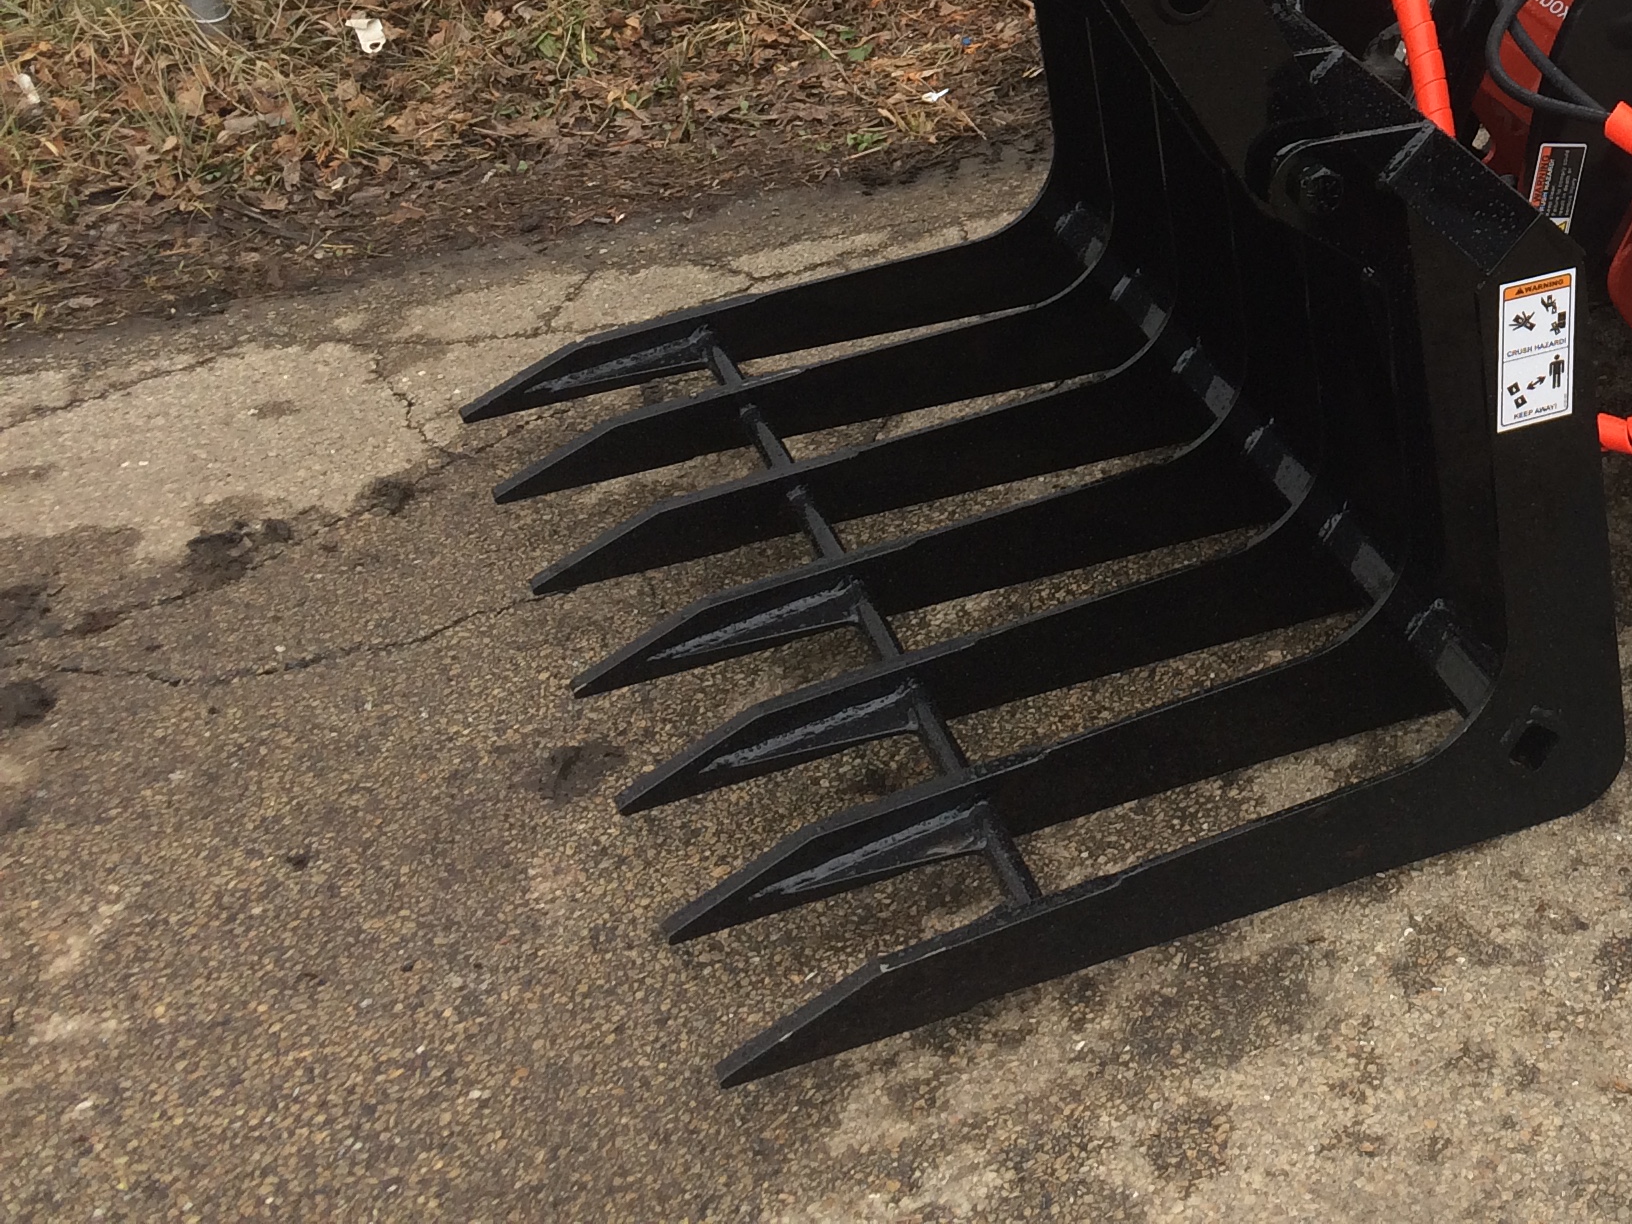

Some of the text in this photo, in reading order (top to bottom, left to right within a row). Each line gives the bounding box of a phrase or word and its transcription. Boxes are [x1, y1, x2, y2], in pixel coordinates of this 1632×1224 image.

[1532, 155, 1550, 203] WARNING
[1524, 278, 1564, 294] WARNING
[1507, 338, 1567, 358] CRUSH HAZARD!
[1514, 409, 1534, 420] KEEP
